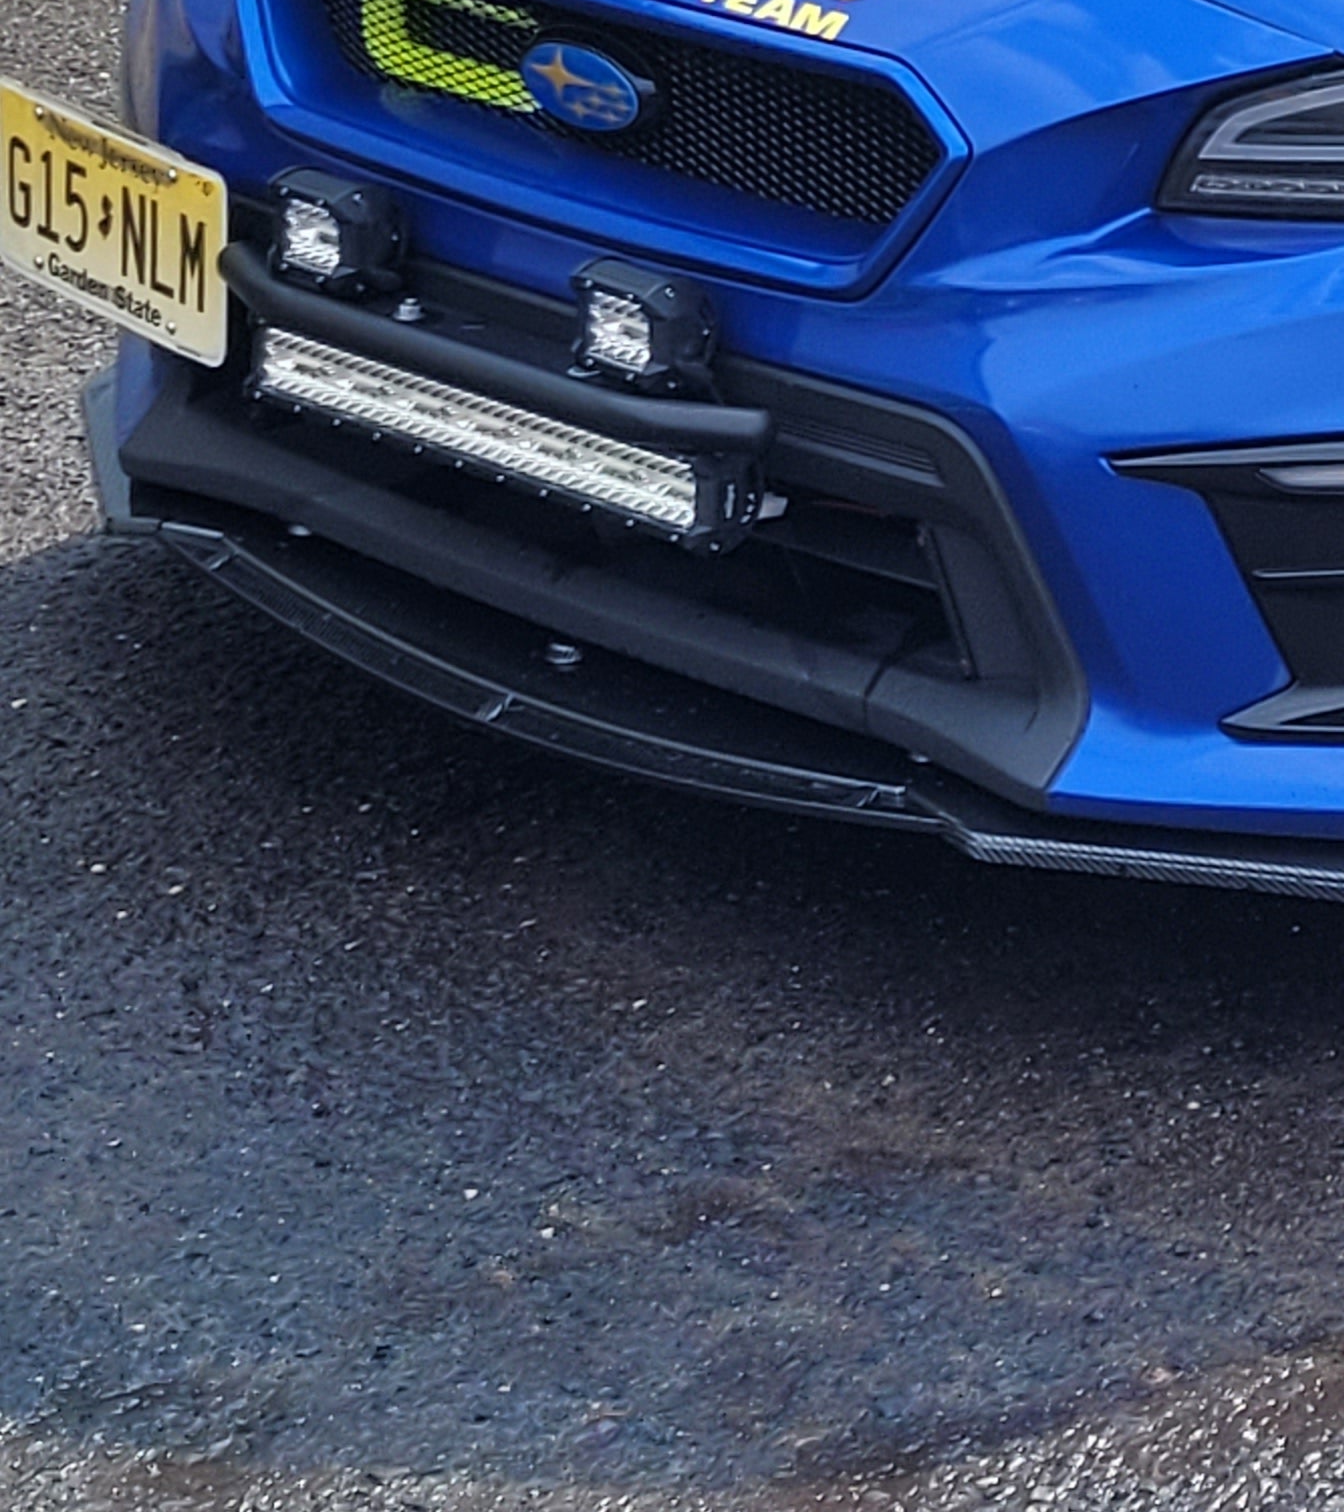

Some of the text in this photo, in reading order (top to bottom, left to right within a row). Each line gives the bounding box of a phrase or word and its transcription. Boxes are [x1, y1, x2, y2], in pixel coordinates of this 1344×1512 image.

[8, 135, 207, 314] G15 NLM
[48, 251, 163, 328] Garden State
